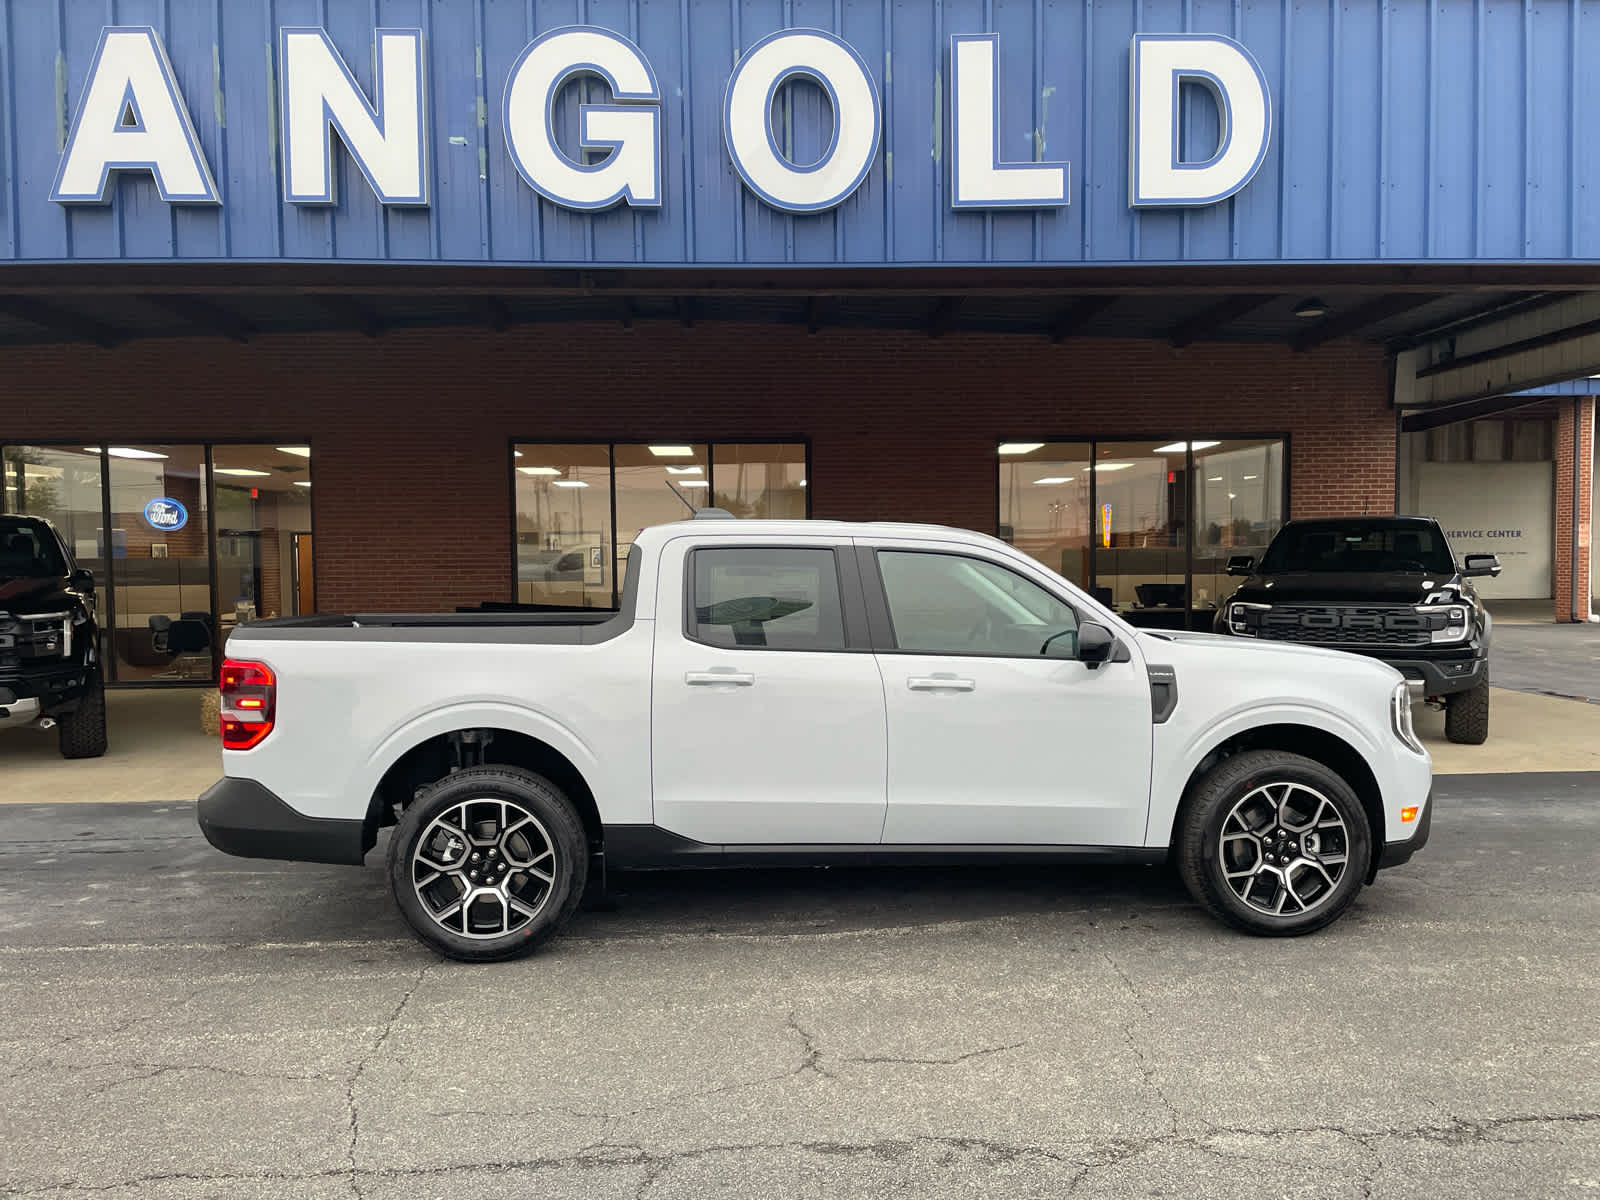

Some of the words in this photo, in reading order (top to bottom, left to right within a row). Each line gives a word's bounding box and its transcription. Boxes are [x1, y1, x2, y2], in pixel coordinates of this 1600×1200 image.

[49, 25, 1271, 212] ANGOLD
[150, 502, 178, 524] Ford
[1446, 530, 1482, 538] SERVICE
[1486, 530, 1522, 538] CENTER
[1261, 613, 1425, 630] FORD
